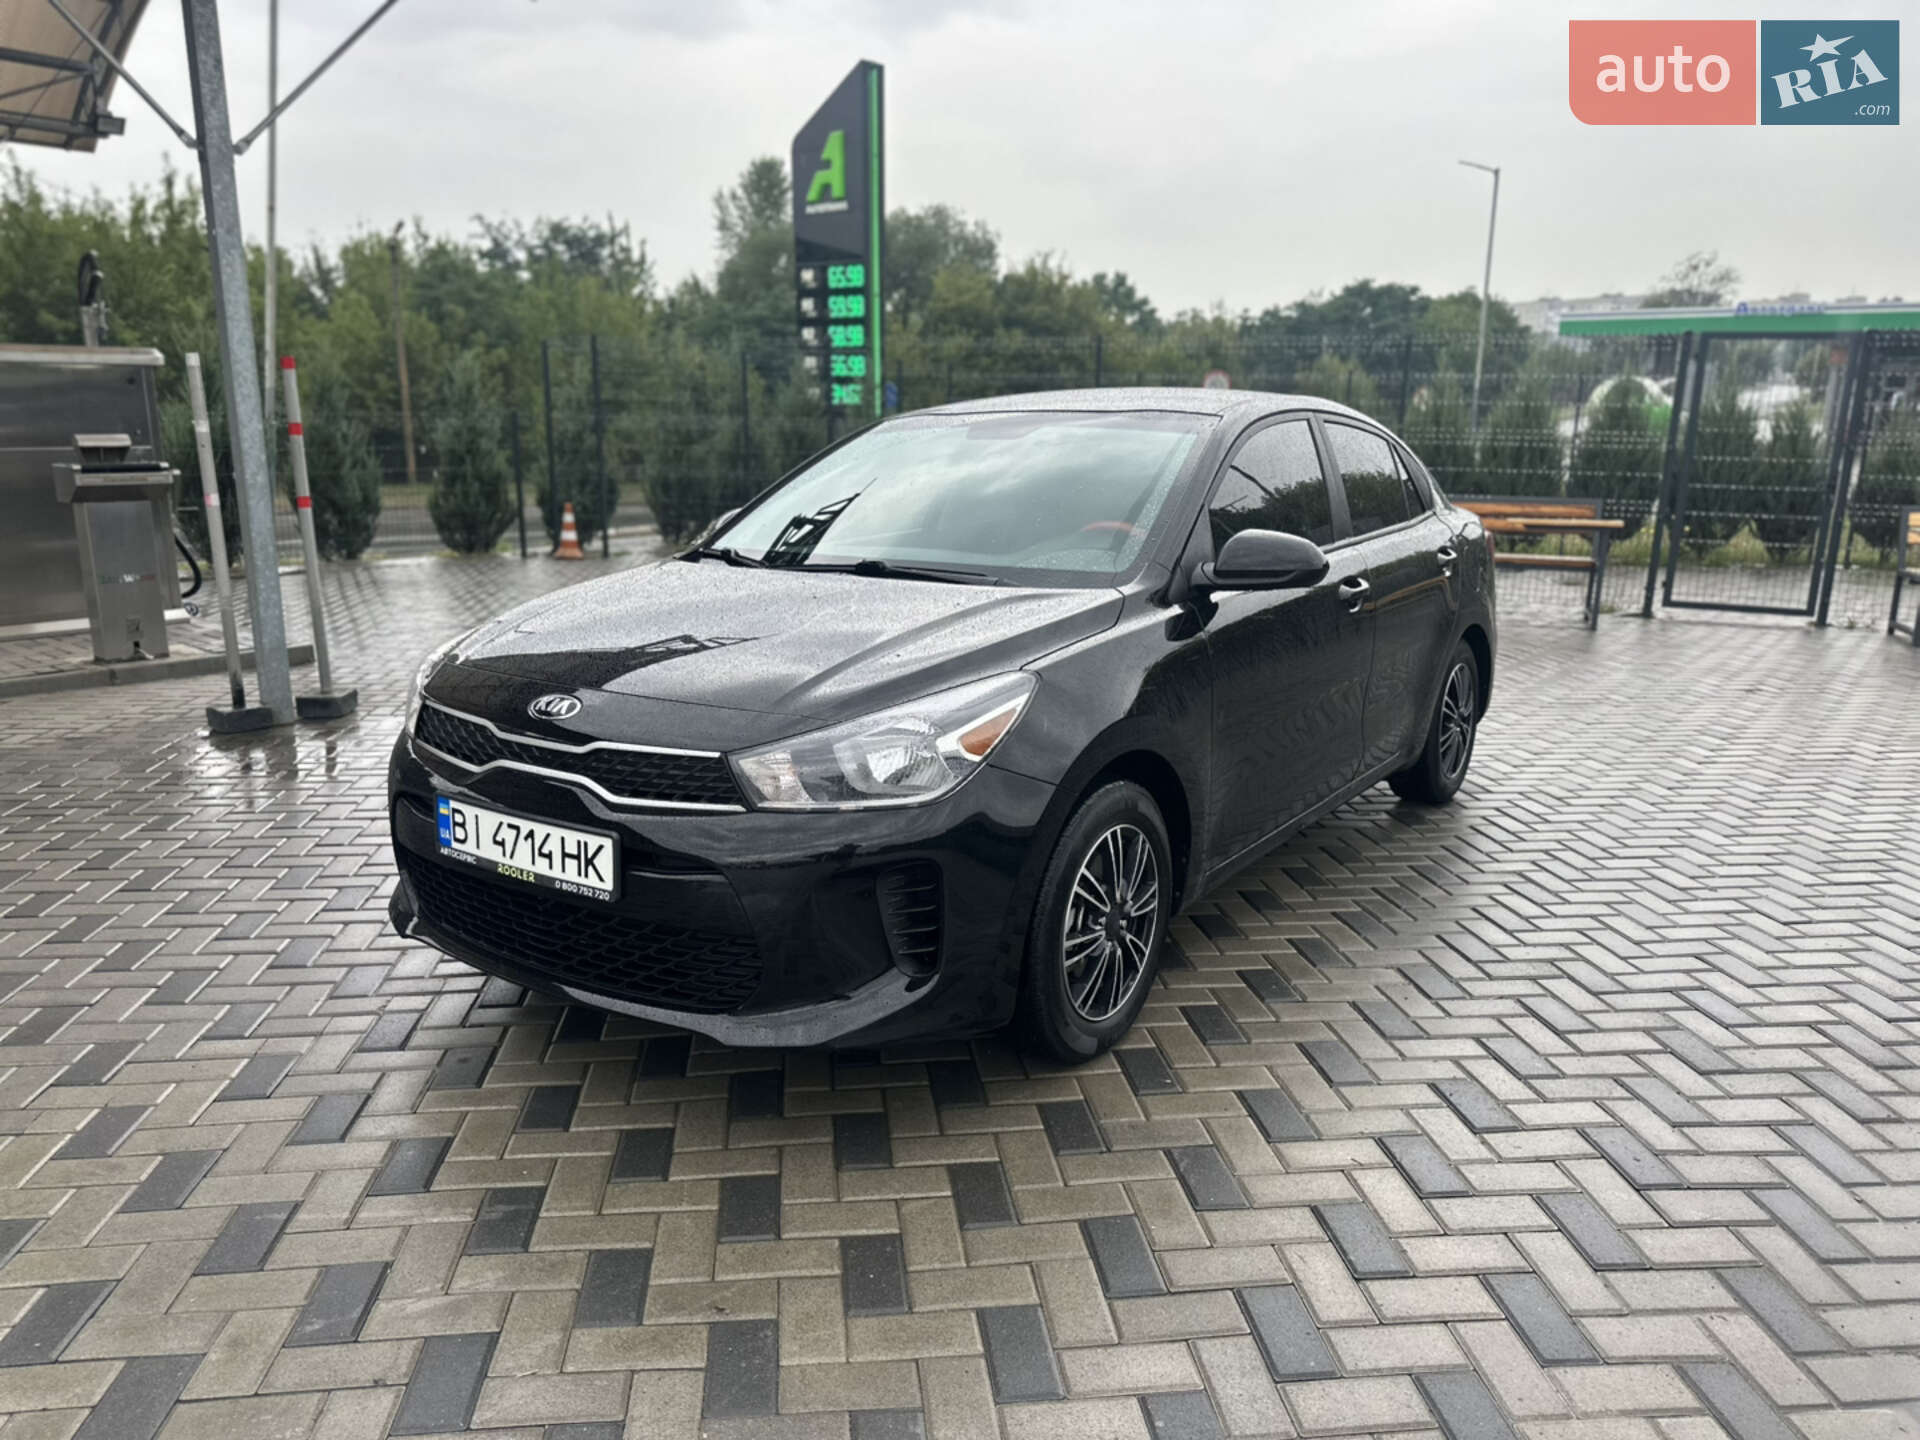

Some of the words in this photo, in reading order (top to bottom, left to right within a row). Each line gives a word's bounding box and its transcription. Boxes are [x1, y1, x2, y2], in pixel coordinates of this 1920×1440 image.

[535, 696, 573, 715] KIA
[440, 827, 451, 840] UA
[451, 807, 480, 850] BI
[492, 820, 553, 871] 4714
[561, 836, 606, 884] HK
[594, 889, 610, 901] 720
